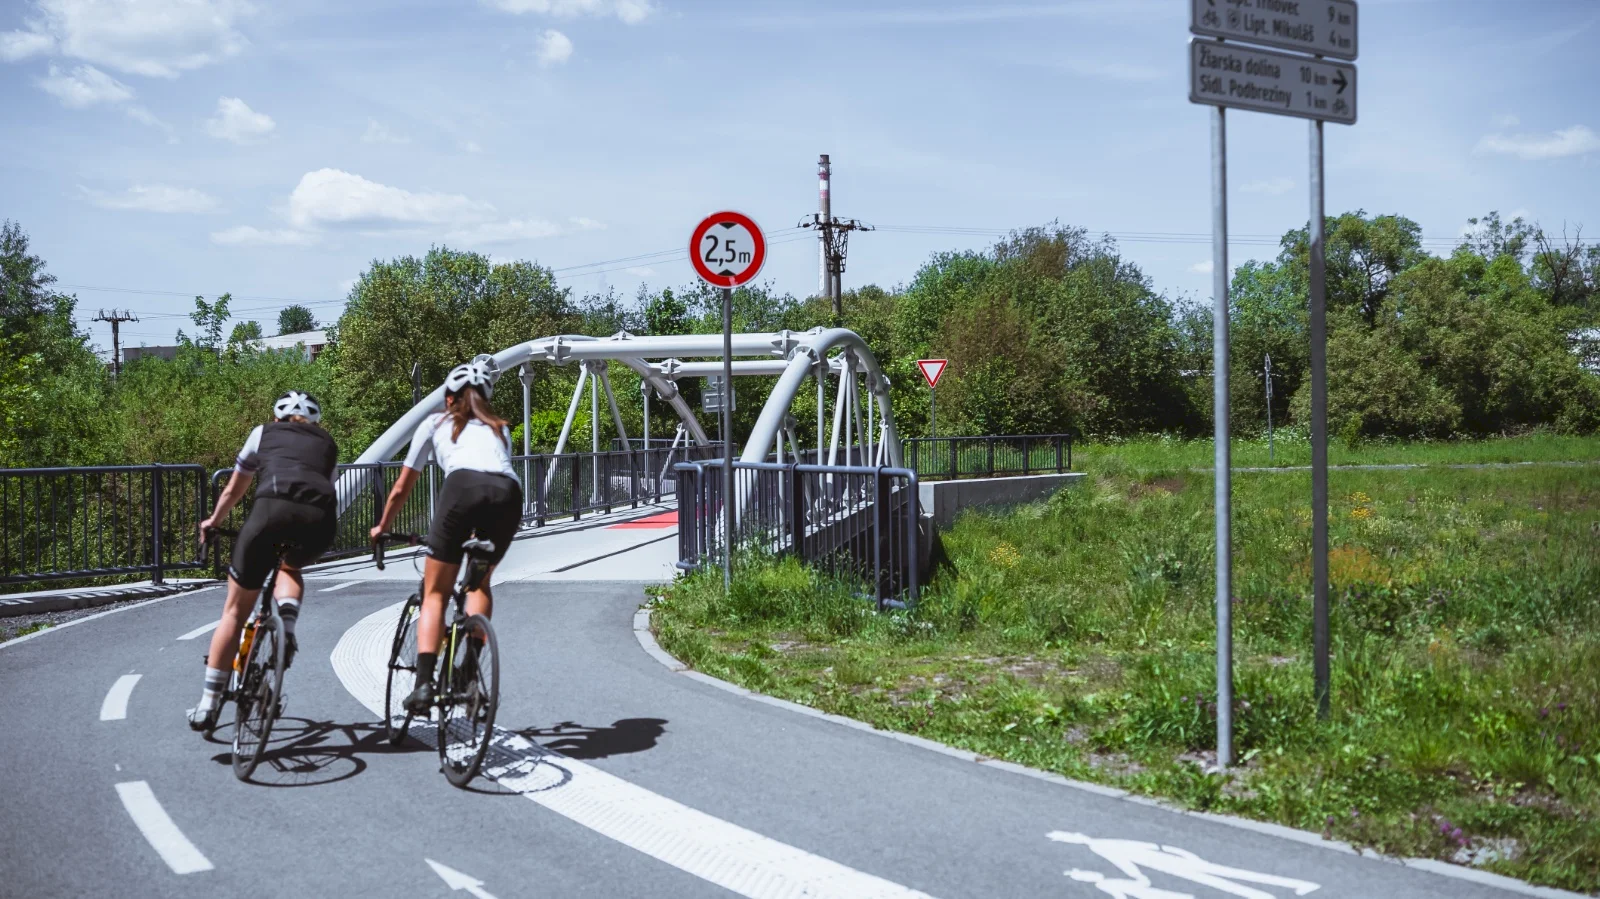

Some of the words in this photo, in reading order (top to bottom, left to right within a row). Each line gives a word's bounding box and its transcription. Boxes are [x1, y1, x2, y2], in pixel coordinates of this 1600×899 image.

[1244, 13, 1269, 36] Lipt.
[1272, 18, 1315, 42] Mikuláš
[1328, 30, 1336, 46] 4
[1338, 34, 1351, 48] km
[1328, 5, 1335, 22] 9
[1338, 11, 1351, 25] km
[1199, 45, 1242, 73] Žiarska
[1245, 56, 1281, 79] dolina
[1300, 66, 1311, 84] 10
[1314, 71, 1327, 86] km
[1229, 78, 1292, 107] Podbreziny
[1306, 91, 1312, 107] 1
[1314, 95, 1327, 109] km
